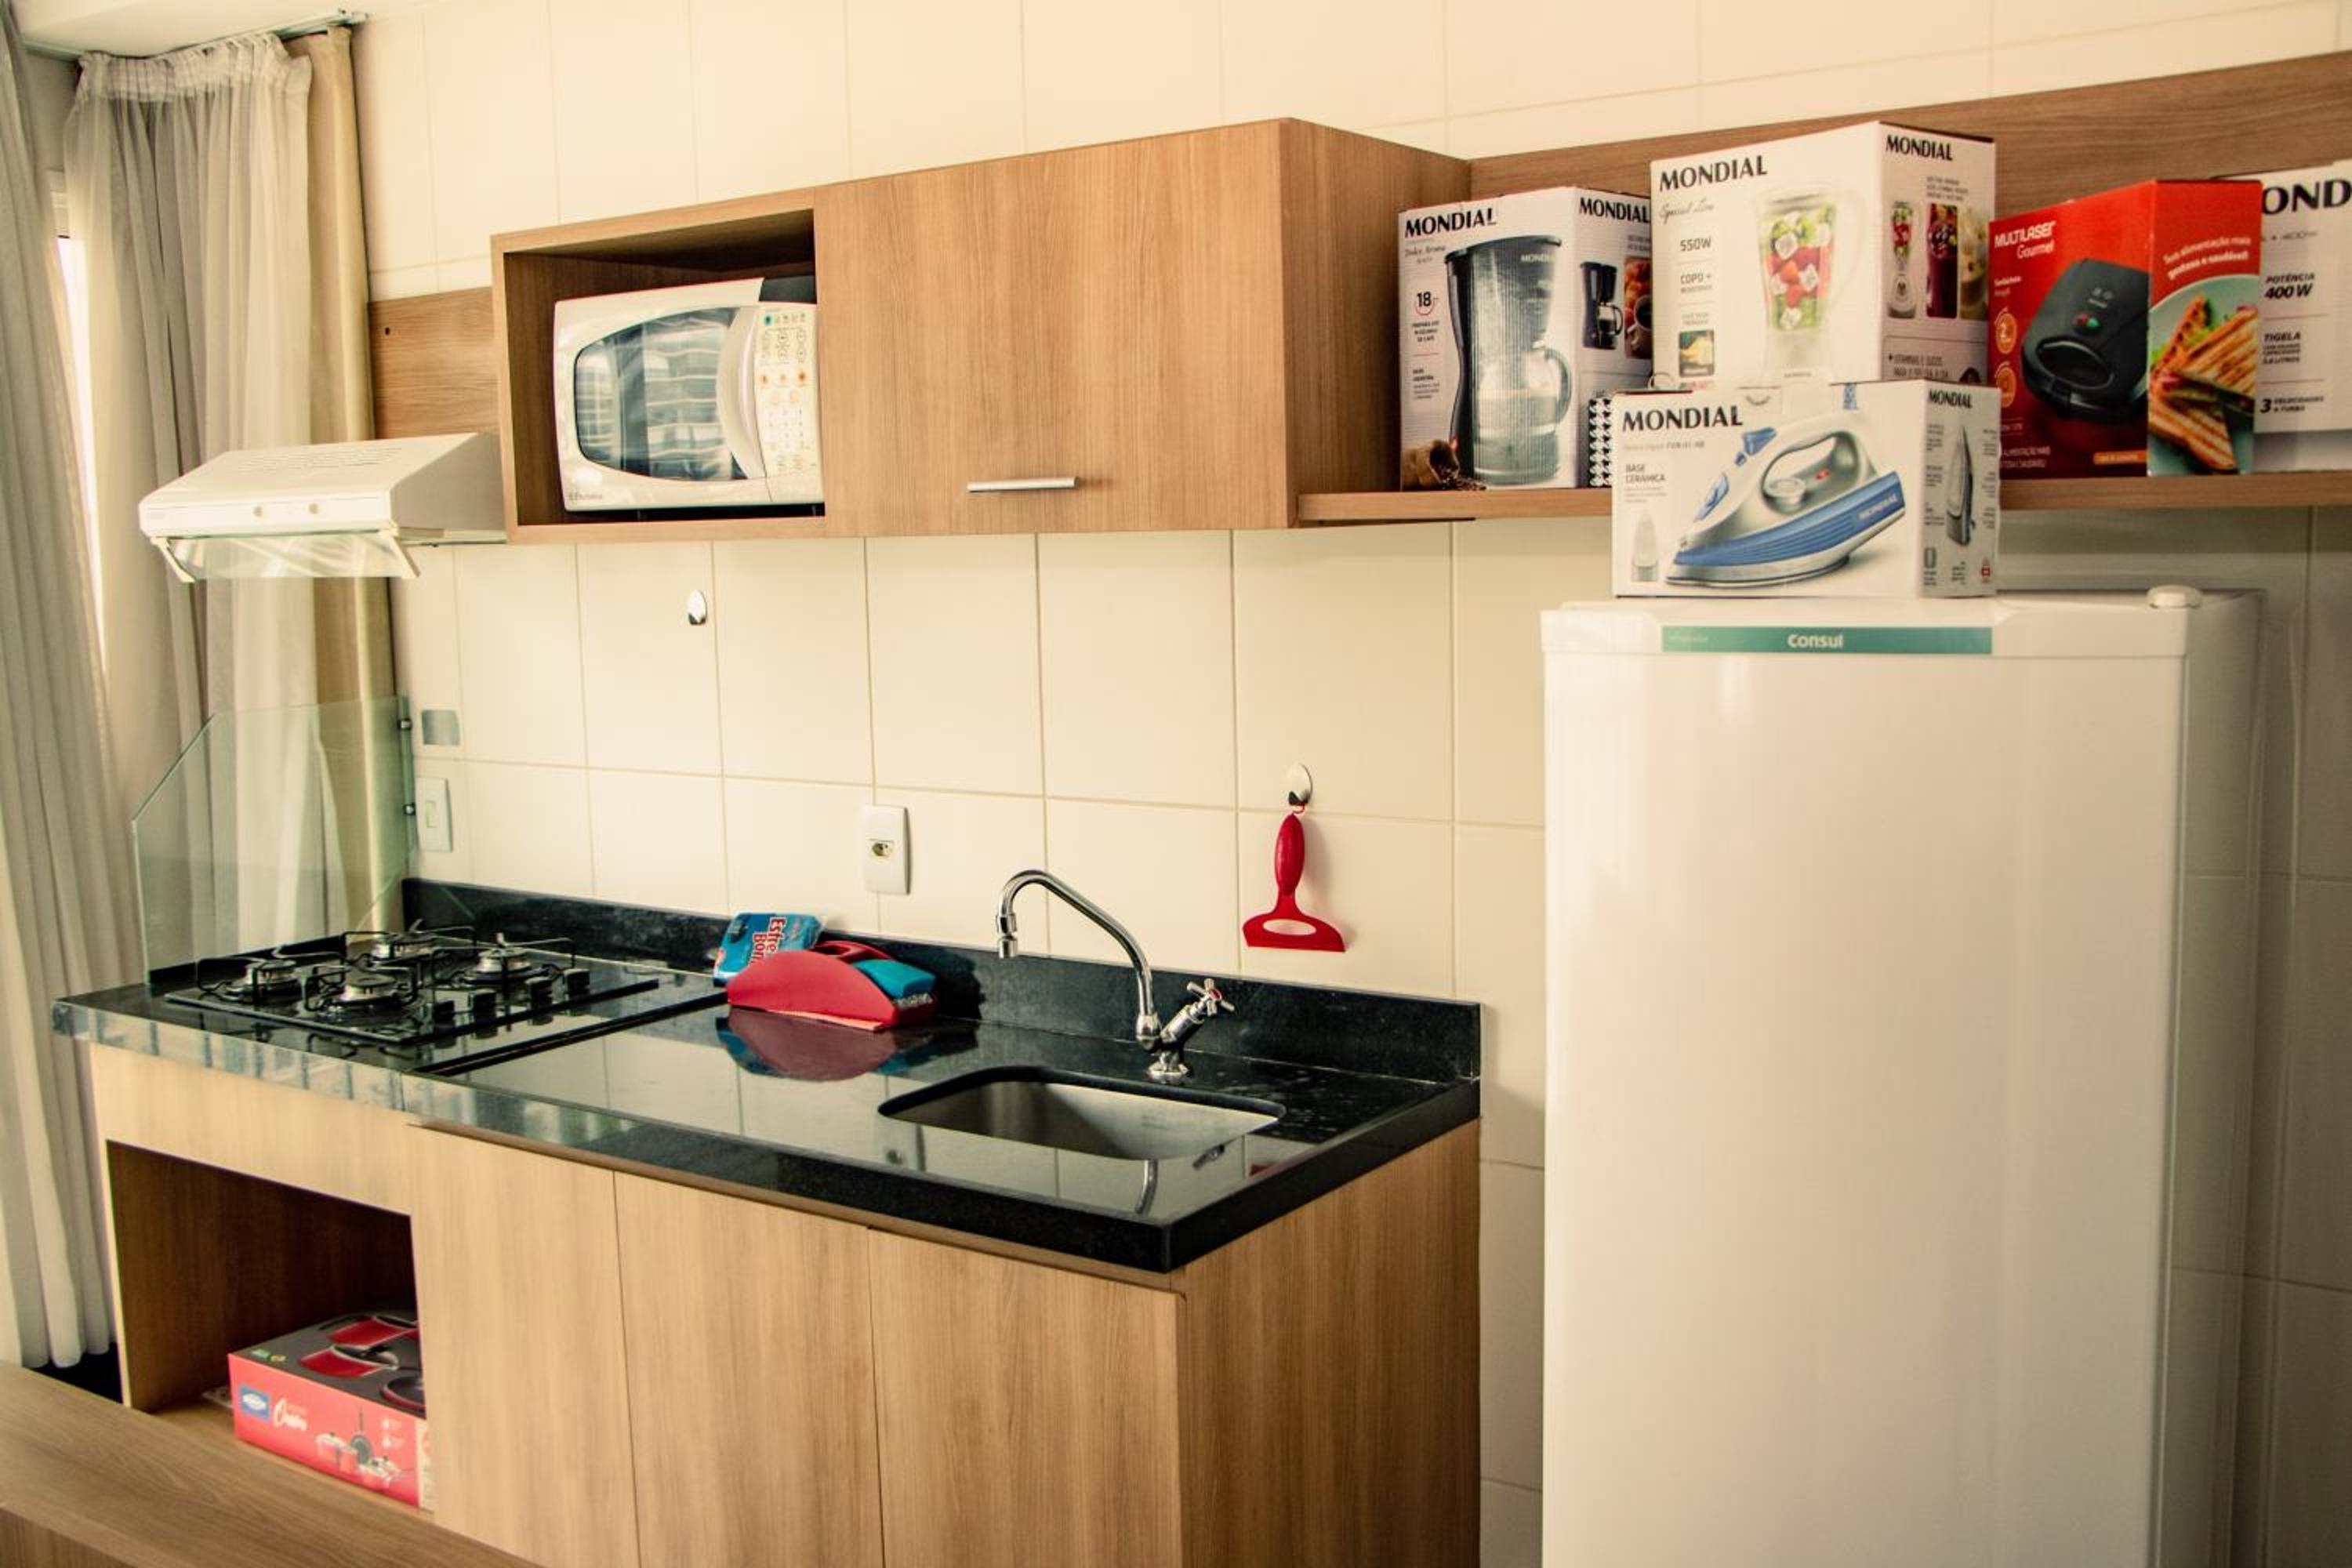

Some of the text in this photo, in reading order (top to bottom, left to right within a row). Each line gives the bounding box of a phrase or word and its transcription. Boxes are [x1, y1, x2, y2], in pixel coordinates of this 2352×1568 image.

[1886, 134, 1954, 162] MONDIAL
[1660, 154, 1768, 192] MONDIAL
[2262, 178, 2352, 216] OND
[1579, 196, 1651, 224] MONDIAL
[1404, 207, 1497, 238] MONDIAL
[1994, 220, 2056, 249] MULTILASER
[1680, 237, 1712, 252] 550W
[2016, 240, 2056, 259] Gourmet
[2265, 271, 2316, 285] POTÊNCIA
[1417, 291, 1432, 307] 18
[2263, 331, 2301, 343] TIGELA
[1928, 389, 1973, 408] MONDIAL
[2259, 397, 2273, 414] 3
[1622, 405, 1744, 432] MONDIAL
[1625, 463, 1646, 473] BASE
[1787, 633, 1844, 649] Consul
